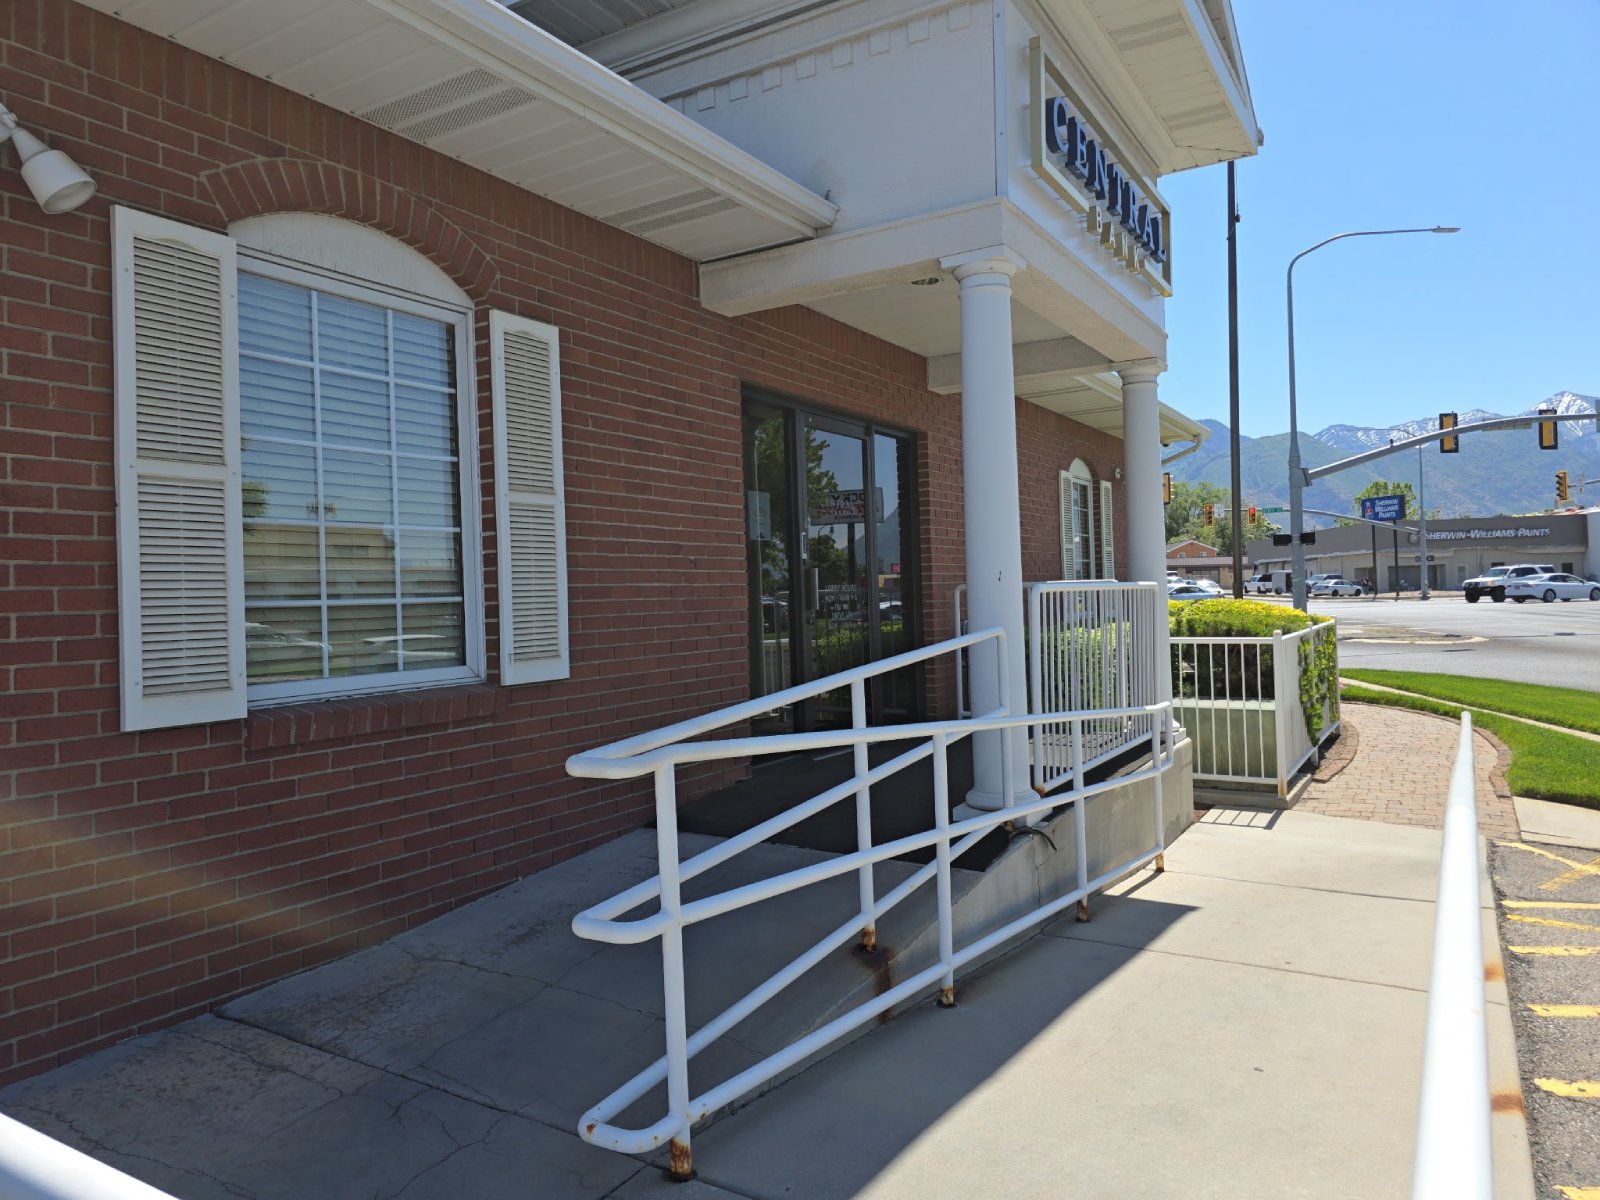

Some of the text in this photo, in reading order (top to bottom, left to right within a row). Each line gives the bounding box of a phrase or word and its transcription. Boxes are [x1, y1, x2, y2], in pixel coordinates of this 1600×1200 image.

[1045, 96, 1166, 264] CENTRAL
[1088, 205, 1141, 272] BANK
[1376, 498, 1398, 506] SHERWIN
[1375, 504, 1399, 512] WILLIAMS
[1379, 510, 1396, 518] PAINTS
[1518, 528, 1551, 537] PAINTS
[841, 584, 857, 592] HOURS
